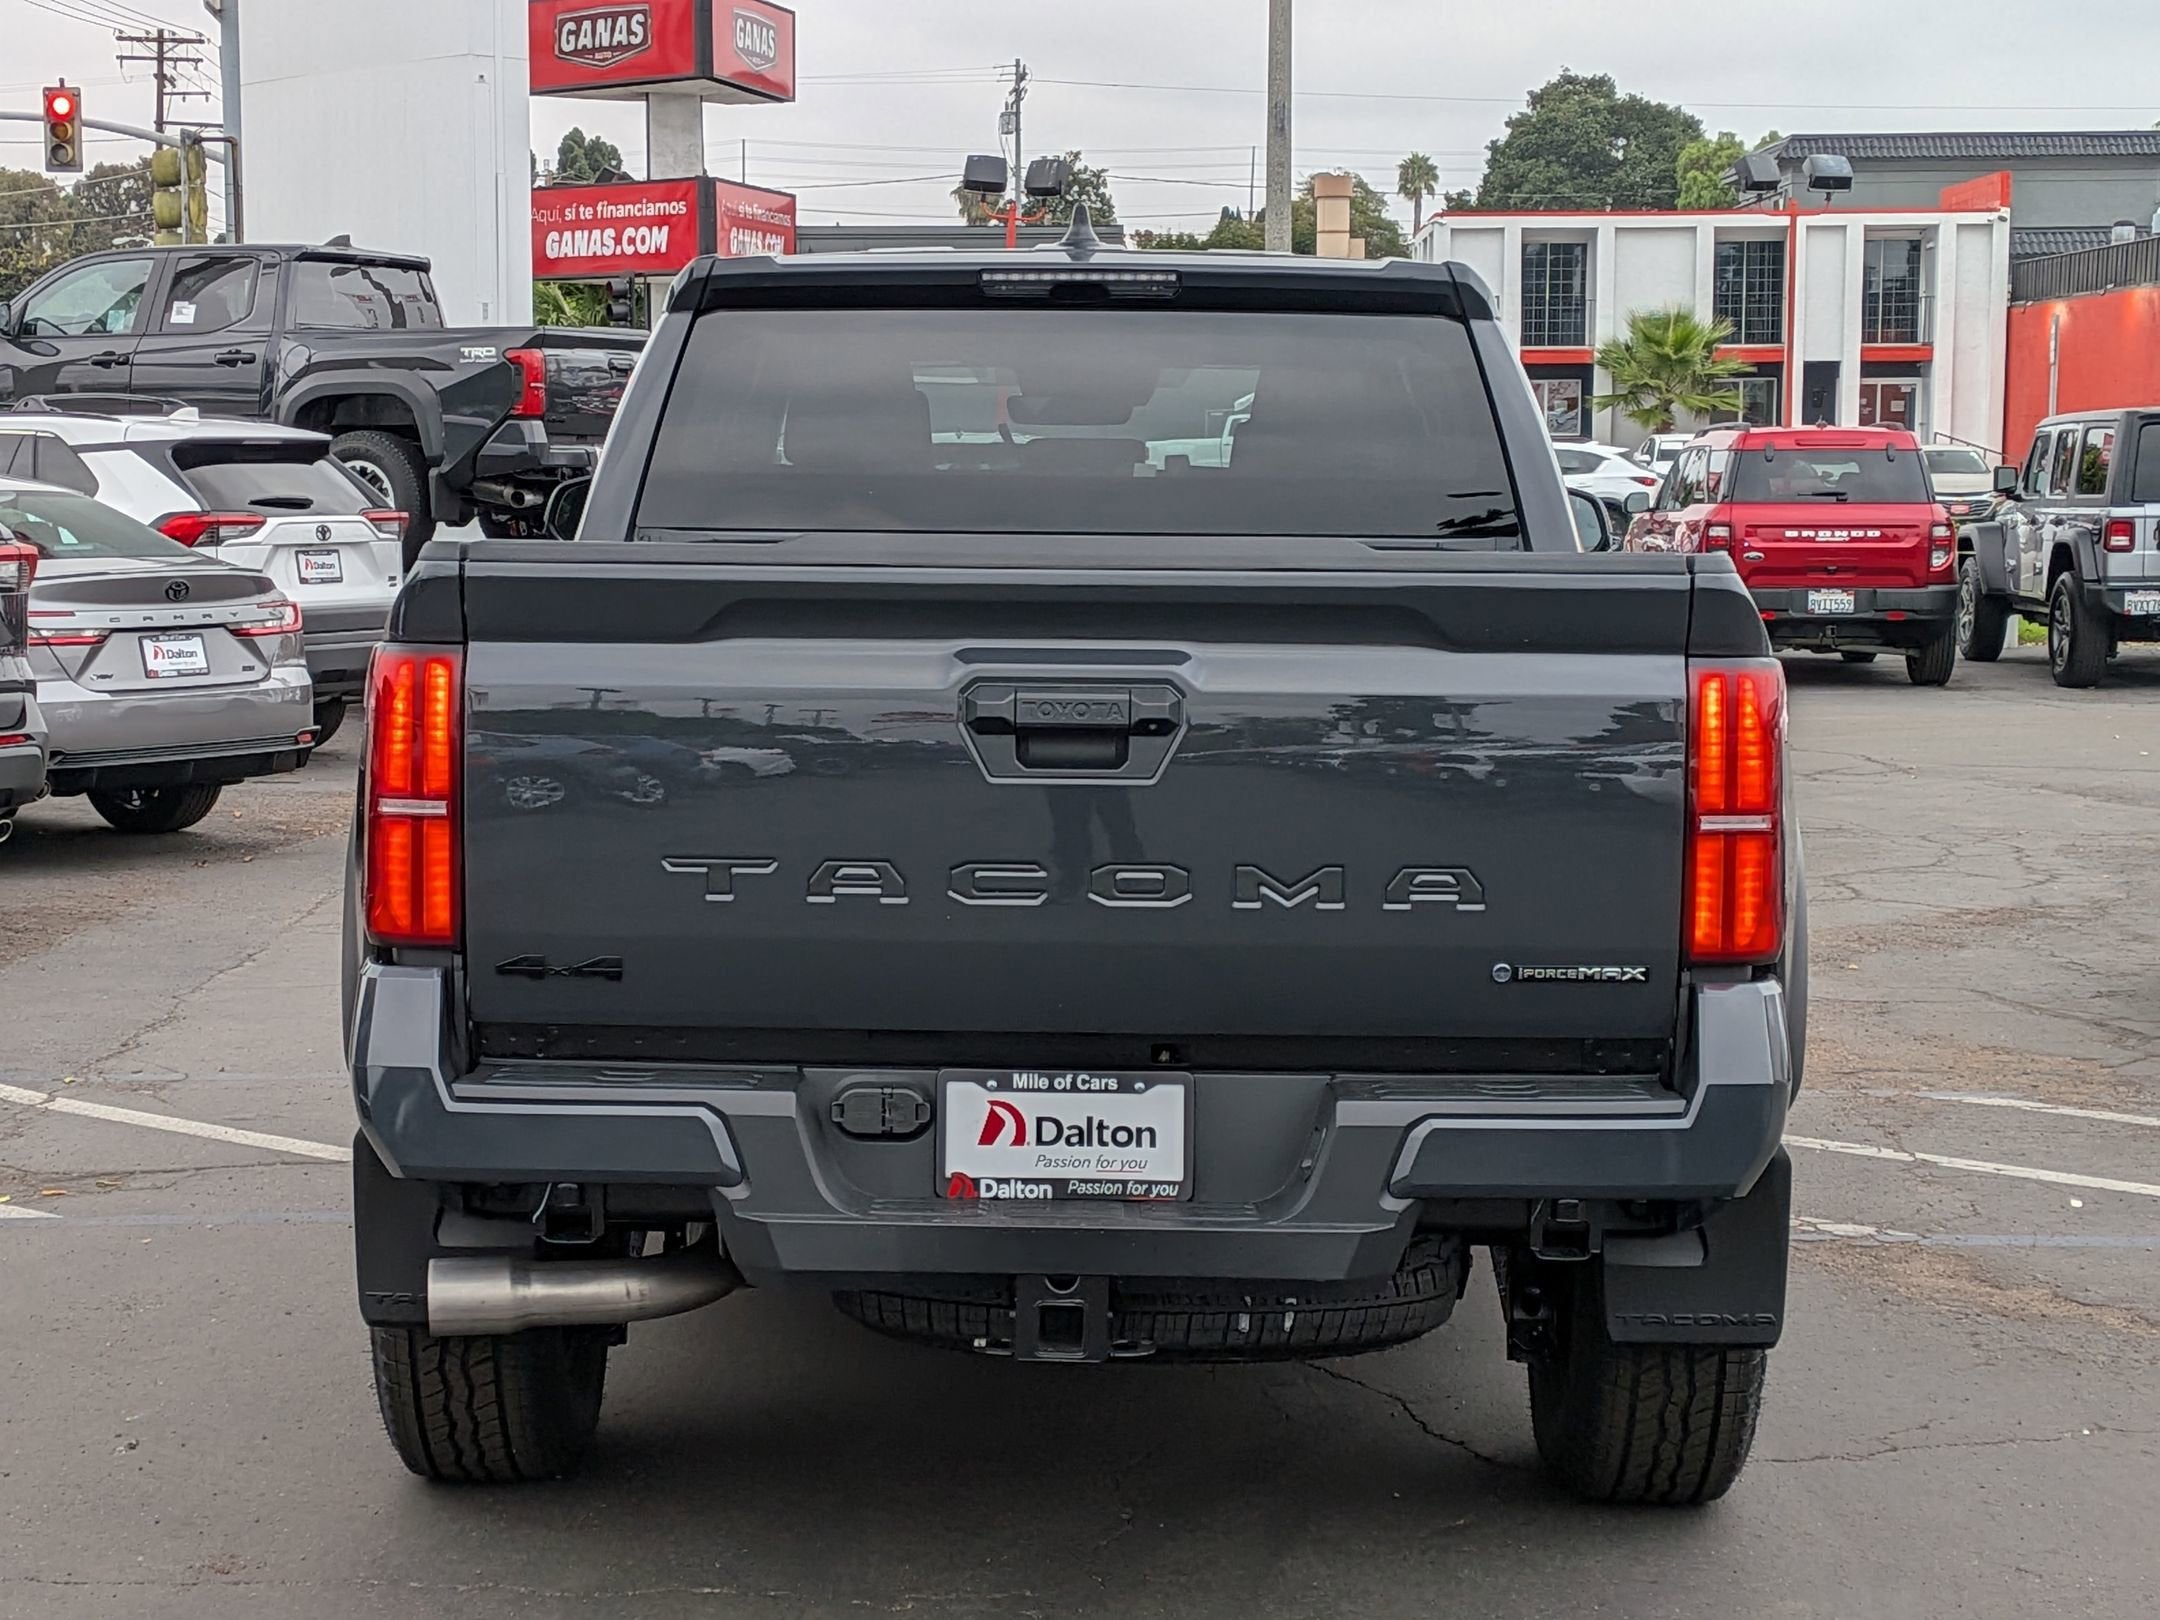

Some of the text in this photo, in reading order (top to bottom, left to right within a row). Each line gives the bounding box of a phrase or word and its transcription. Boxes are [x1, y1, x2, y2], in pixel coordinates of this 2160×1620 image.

[560, 13, 645, 52] GANAS
[736, 18, 775, 58] GANAS
[564, 203, 577, 220] sí
[579, 204, 593, 219] te
[597, 200, 687, 217] financiamos
[545, 226, 669, 258] GANAS.COM
[460, 347, 496, 358] TRD
[1785, 530, 1881, 538] BRONCO
[314, 562, 336, 570] Dalton
[109, 611, 239, 624] CAMRY
[166, 648, 198, 659] Dalton
[1021, 701, 1125, 720] TOYOTA
[661, 857, 1487, 911] TACOMA
[1013, 1073, 1119, 1091] Mile of Cars
[1035, 1116, 1157, 1149] Dalton
[1034, 1154, 1148, 1172] Passion for you
[979, 1178, 1053, 1199] Dalton
[1067, 1181, 1179, 1197] Passion for you
[1615, 1313, 1777, 1327] TACOMA
